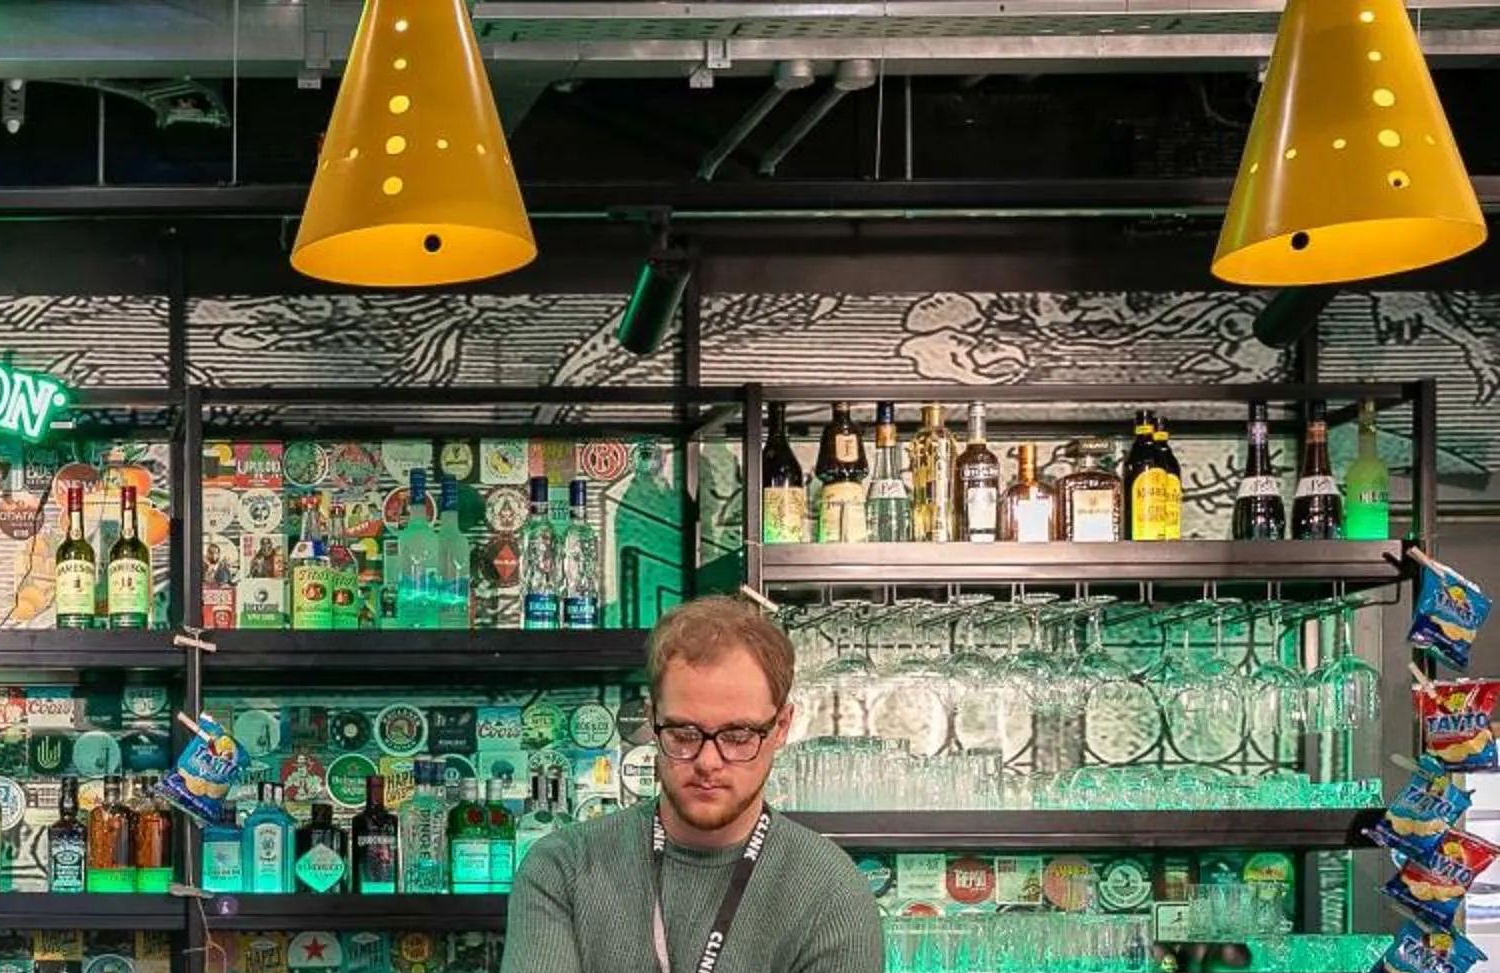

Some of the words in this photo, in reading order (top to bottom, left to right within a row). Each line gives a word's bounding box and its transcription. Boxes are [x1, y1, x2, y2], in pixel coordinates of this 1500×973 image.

[28, 700, 72, 715] Coors
[1427, 712, 1488, 733] TAYTO
[743, 813, 771, 862] CLINK
